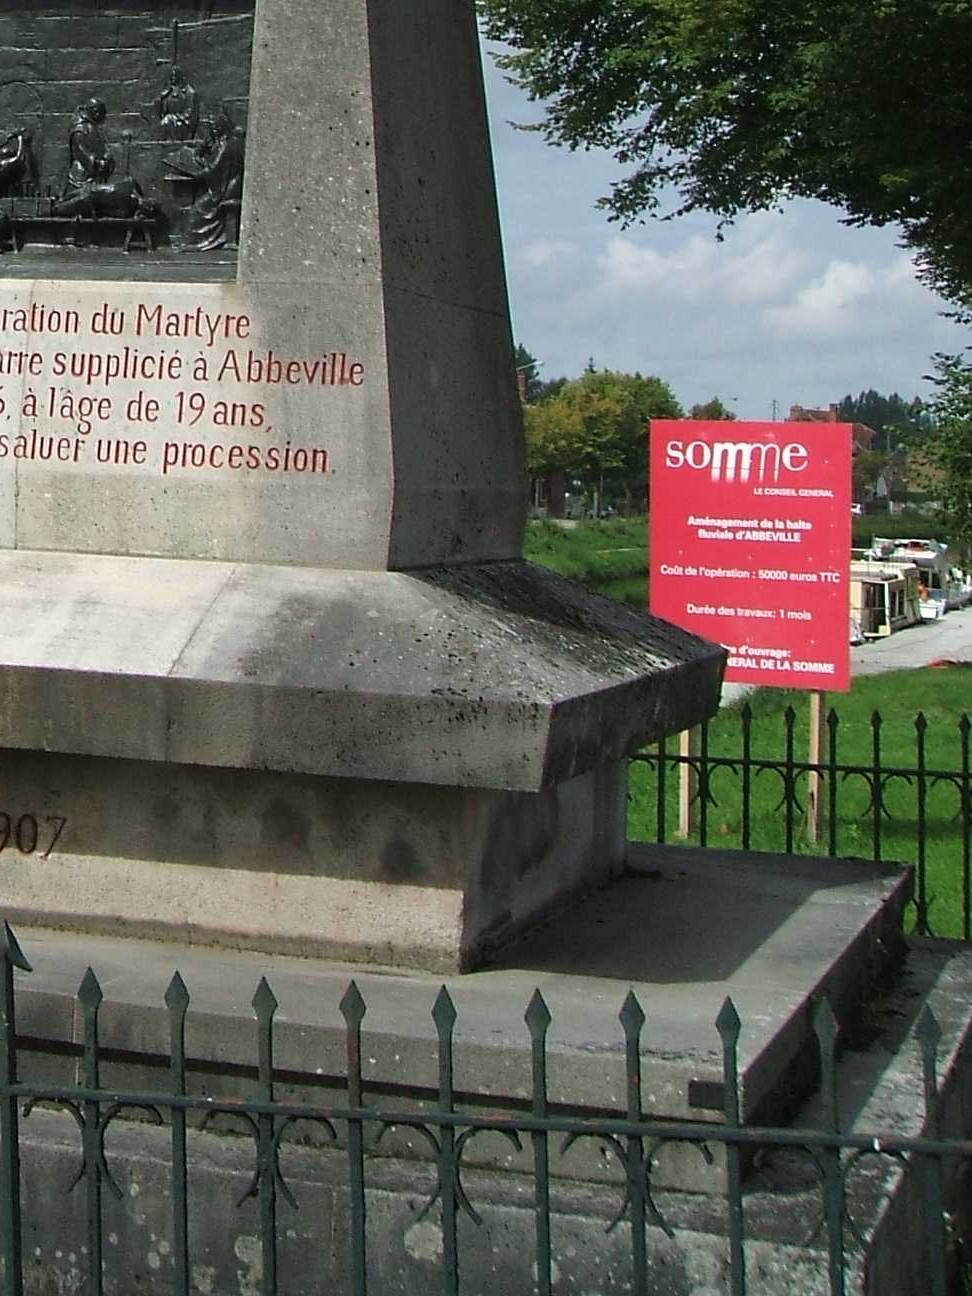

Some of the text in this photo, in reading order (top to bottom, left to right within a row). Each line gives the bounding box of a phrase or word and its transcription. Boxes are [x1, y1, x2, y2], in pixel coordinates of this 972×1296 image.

[91, 303, 125, 336] du
[135, 303, 251, 347] Martyre
[52, 346, 183, 386] supplicié
[192, 350, 209, 382] à
[217, 349, 365, 386] Abbeville
[21, 387, 38, 418] à
[126, 390, 160, 423] de
[175, 392, 206, 426] 19
[212, 401, 273, 433] ans,
[96, 438, 147, 466] une
[665, 439, 809, 484] somme
[753, 487, 763, 496] LE
[687, 515, 812, 530] Aménagement de la halte
[698, 529, 801, 543] fluviale d'ABBEVILLE
[660, 564, 683, 576] Coût
[685, 566, 697, 577] de
[699, 566, 750, 580] l'opération
[758, 569, 788, 581] 50000
[789, 571, 818, 582] euros
[819, 572, 840, 583] TTC
[687, 603, 715, 615] Durée
[717, 606, 735, 616] des
[779, 609, 785, 619] 1
[787, 610, 812, 621] mois
[760, 659, 775, 670] DE
[776, 660, 790, 671] LA
[792, 660, 835, 674] SOMME
